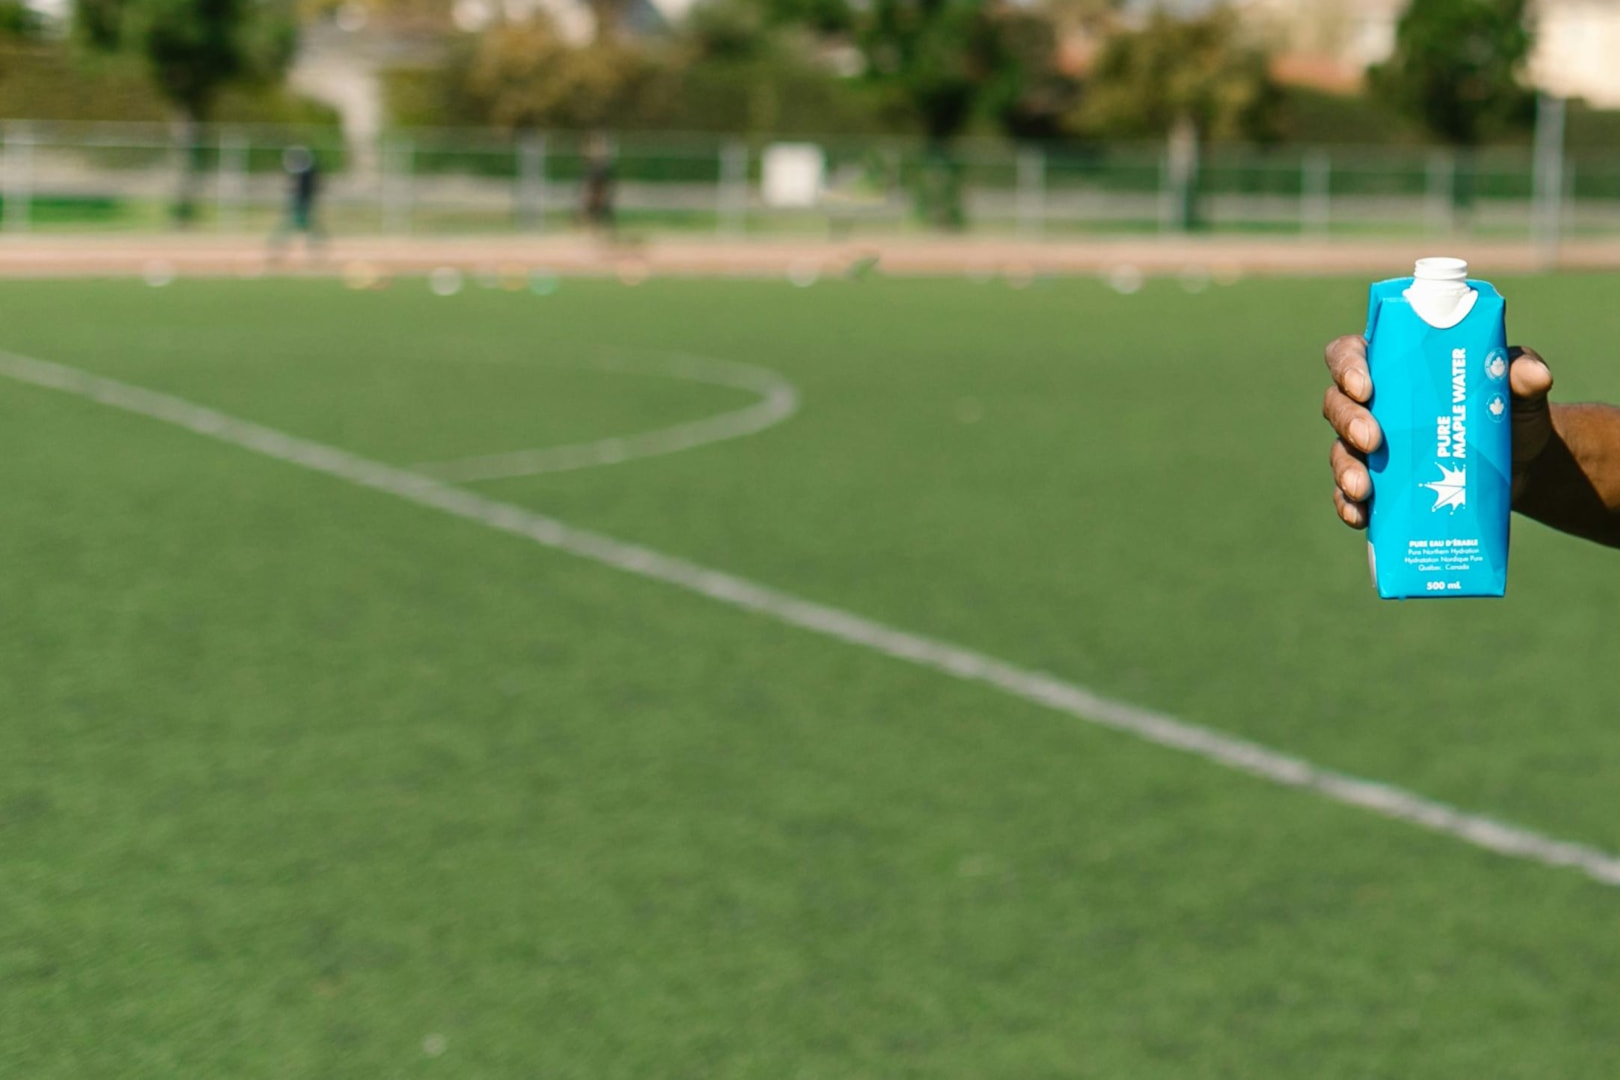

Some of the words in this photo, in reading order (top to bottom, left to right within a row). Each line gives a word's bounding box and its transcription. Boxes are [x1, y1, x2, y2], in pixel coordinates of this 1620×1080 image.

[1452, 348, 1466, 403] WATER
[1437, 416, 1451, 457] PURE
[1452, 405, 1466, 459] MAPLE
[1409, 540, 1428, 548] PURE
[1426, 581, 1445, 590] 500
